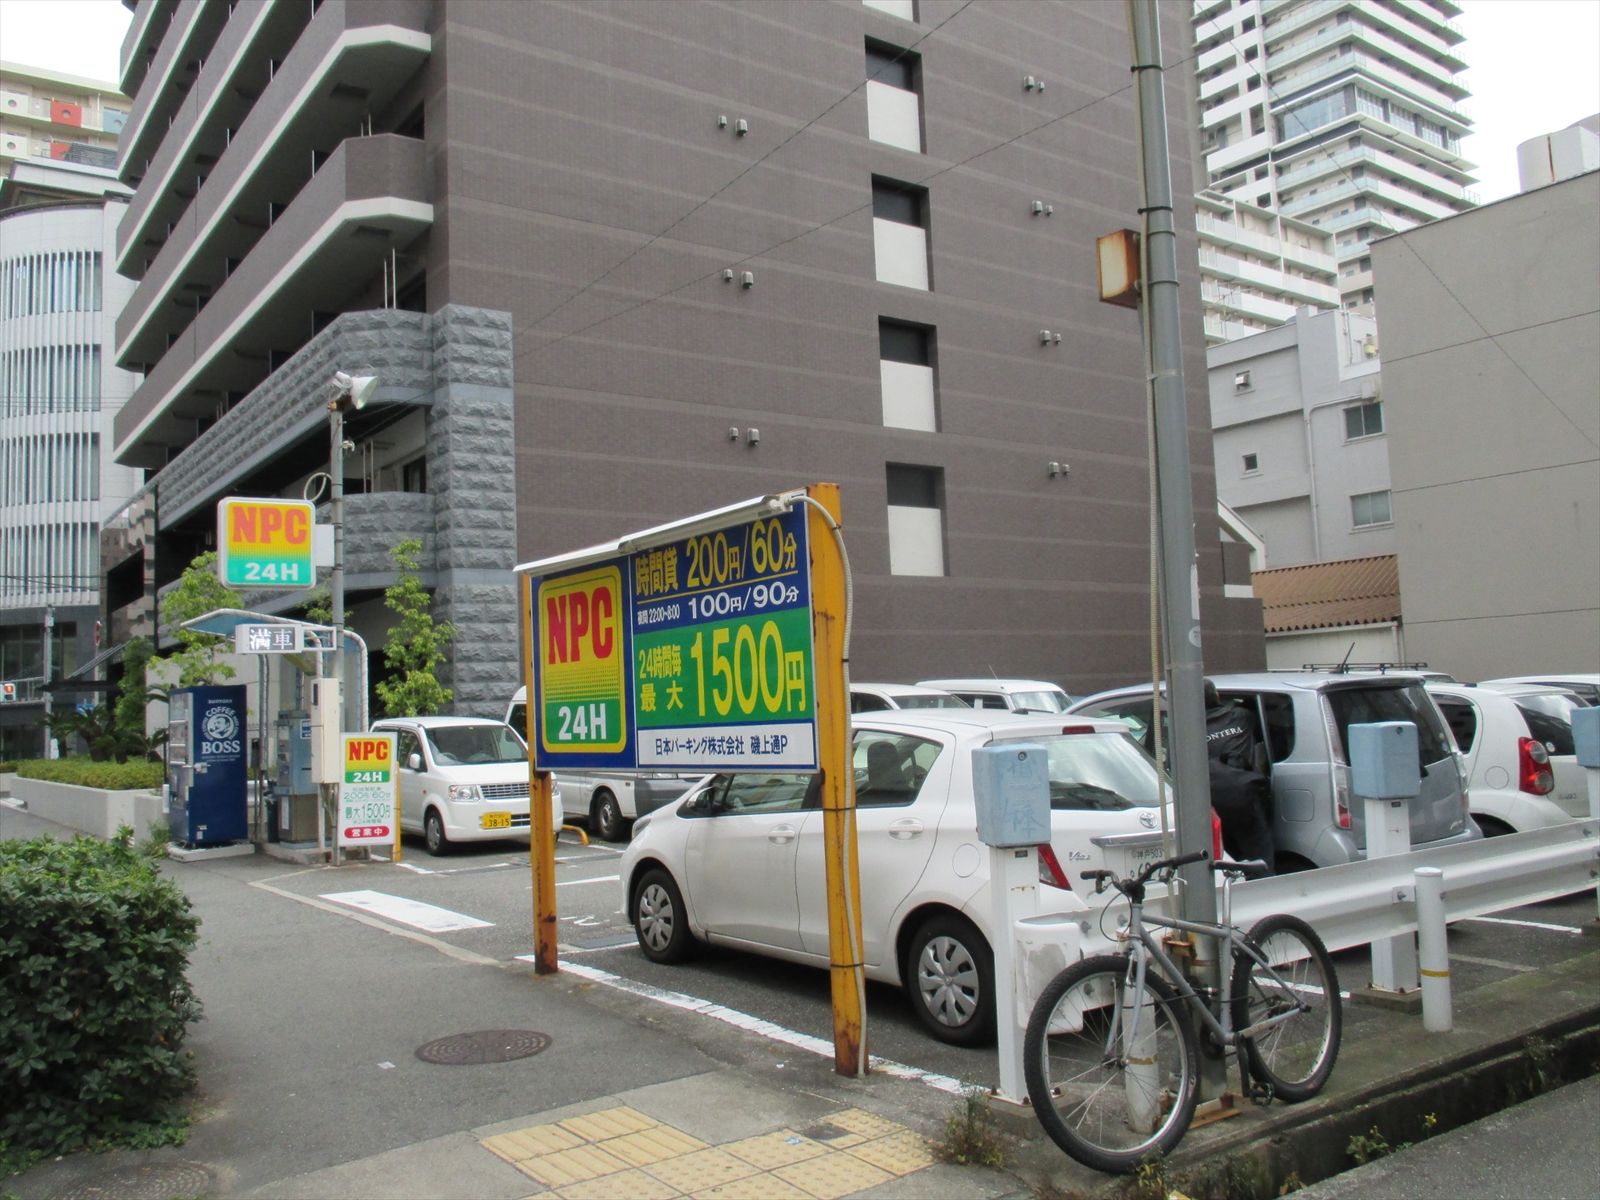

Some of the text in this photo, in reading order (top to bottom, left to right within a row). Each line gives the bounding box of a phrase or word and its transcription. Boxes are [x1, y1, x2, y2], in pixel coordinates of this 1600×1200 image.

[232, 506, 307, 544] NPC
[686, 518, 797, 589] 200円/60分
[245, 562, 299, 581] 24H
[689, 581, 799, 619] 100円/90分
[546, 586, 613, 665] NPC
[250, 629, 293, 650] 満車
[639, 644, 682, 680] 24時間毎
[691, 620, 806, 716] 1500円
[206, 706, 236, 717] COFFEE
[558, 703, 607, 741] 24H
[201, 740, 241, 754] BOSS
[348, 741, 389, 761] NPC
[655, 734, 788, 756] 日本パーキング株式会社 磯上通P
[353, 771, 383, 783] 24H
[351, 827, 383, 837] 営業中
